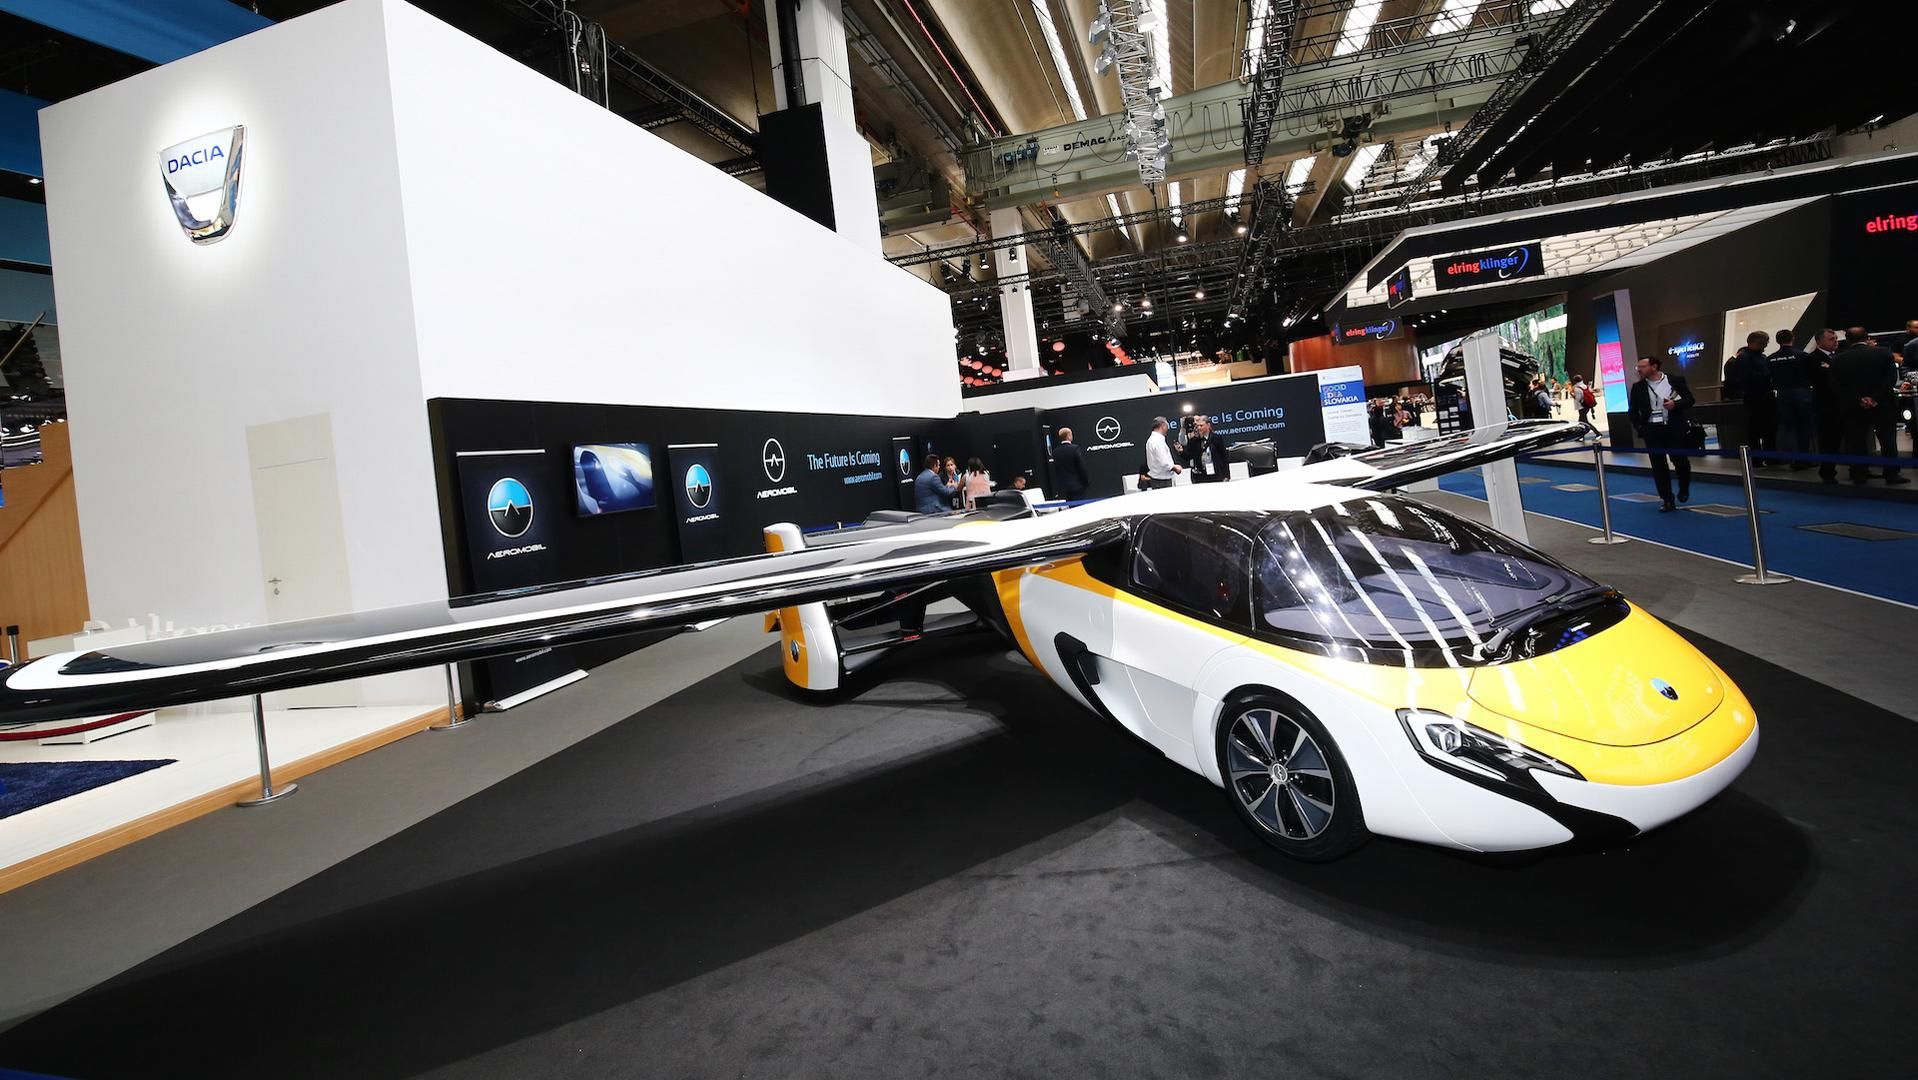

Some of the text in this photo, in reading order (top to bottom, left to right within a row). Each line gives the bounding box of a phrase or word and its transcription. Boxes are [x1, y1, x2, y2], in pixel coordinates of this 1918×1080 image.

[1063, 136, 1106, 152] DEMAG
[168, 145, 225, 174] DACIA
[1866, 214, 1918, 233] elring
[1447, 255, 1519, 275] elringklinger
[1324, 396, 1359, 405] SLOVAKIA
[1222, 412, 1233, 423] Is
[1235, 407, 1284, 421] Coming
[1086, 442, 1135, 452] AEROMOBIL
[807, 449, 881, 470] The Future Is Coming
[756, 486, 798, 499] AEROMOBIL
[685, 513, 720, 524] AEROMOBIL
[486, 543, 547, 560] AEROMOBIL
